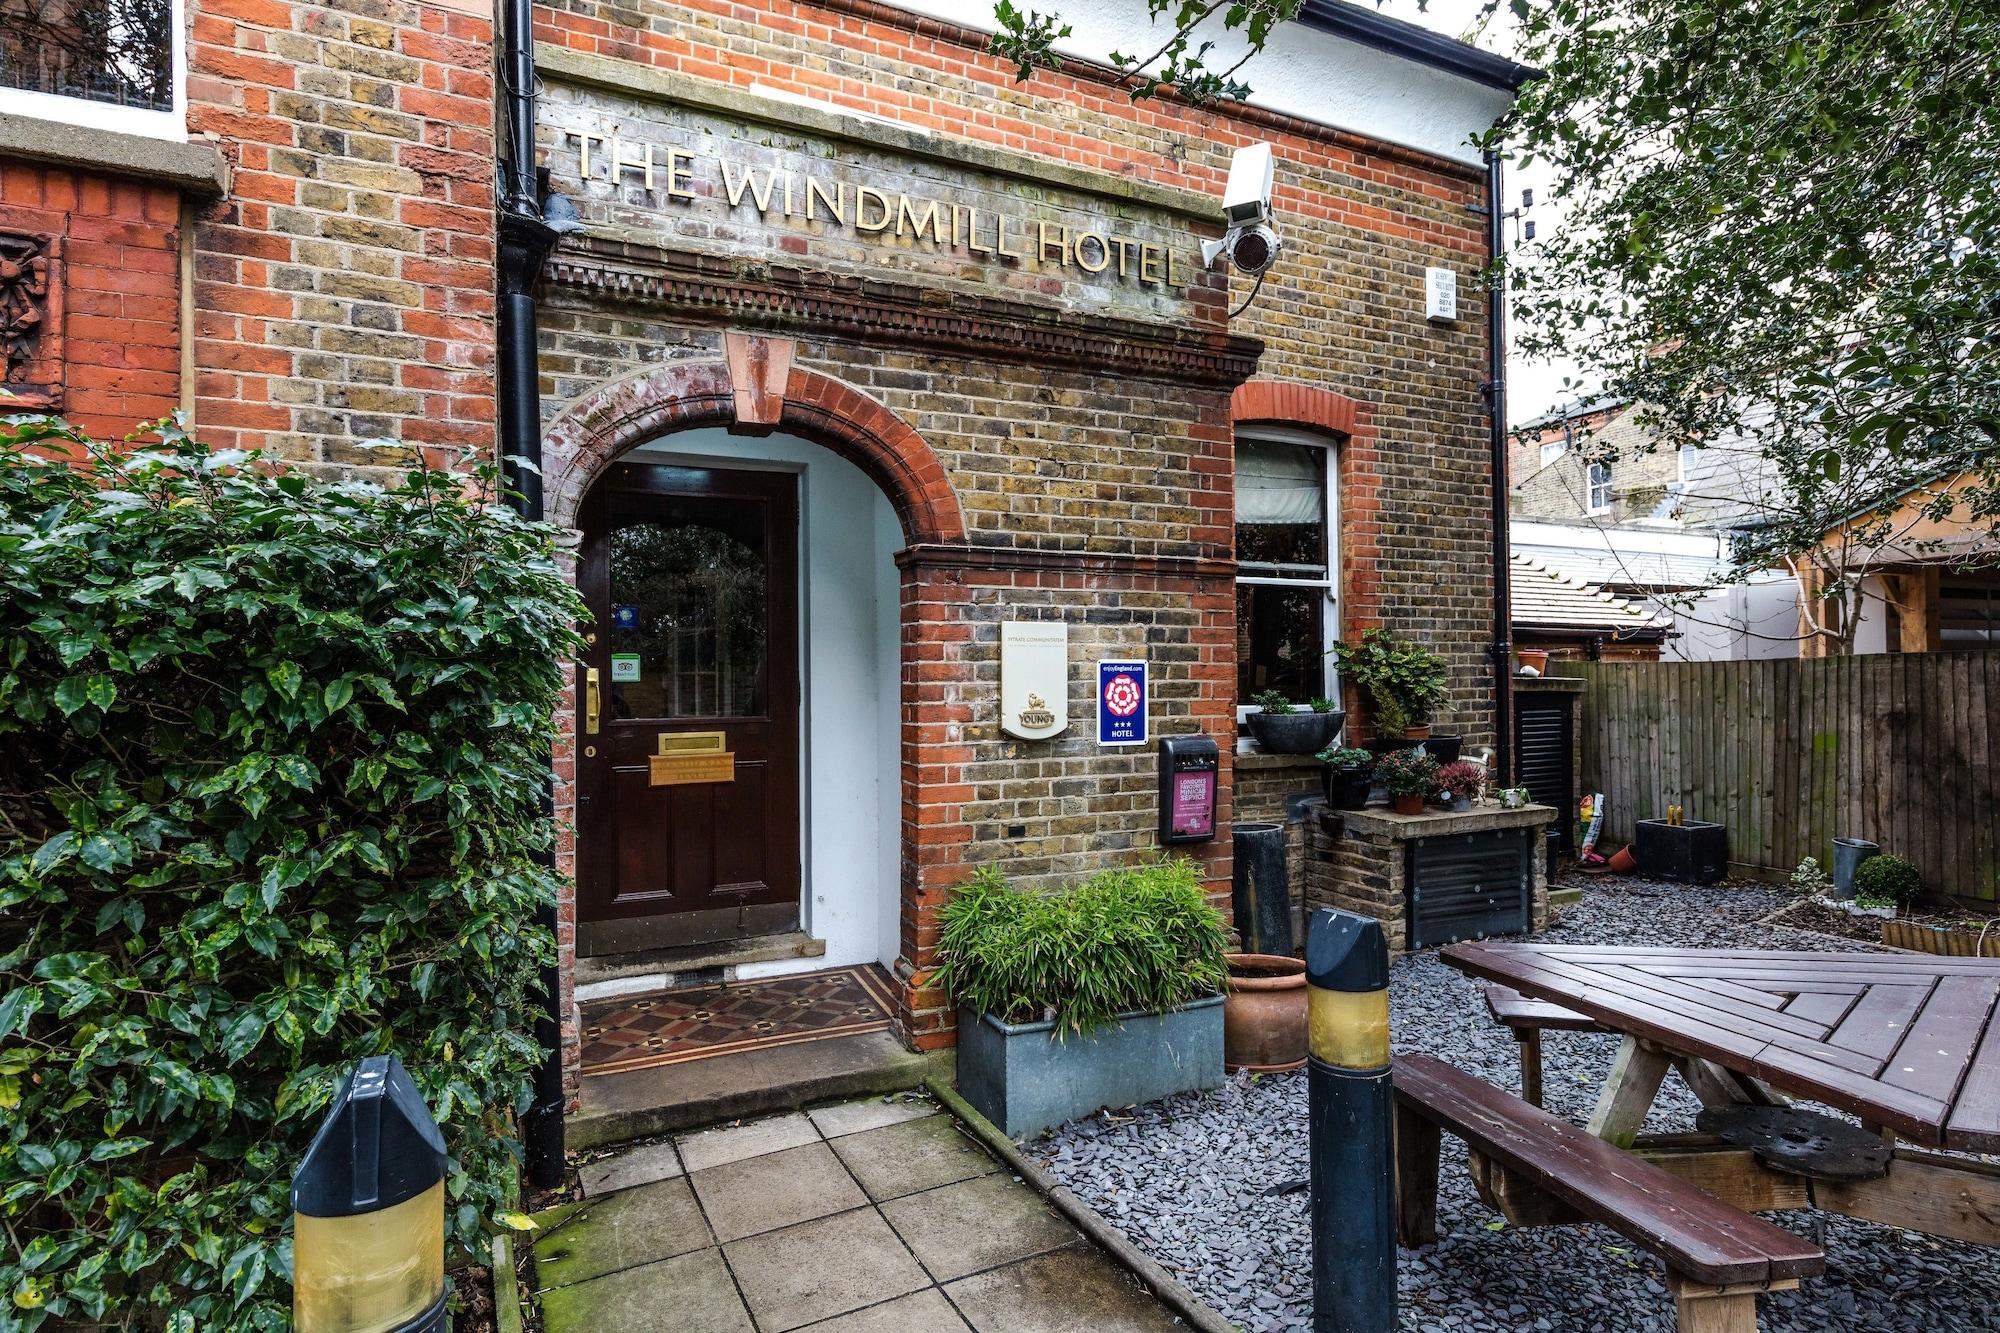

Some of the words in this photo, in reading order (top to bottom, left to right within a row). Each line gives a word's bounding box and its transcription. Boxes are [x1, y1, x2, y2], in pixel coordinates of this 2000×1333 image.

[565, 127, 697, 199] THE
[718, 157, 1018, 258] WINDMILL
[1037, 222, 1186, 288] HOTEL
[1440, 291, 1451, 299] 020
[1439, 298, 1452, 306] 8874
[1103, 665, 1143, 673] enjoyEngland.com
[1111, 730, 1134, 738] HOTEL
